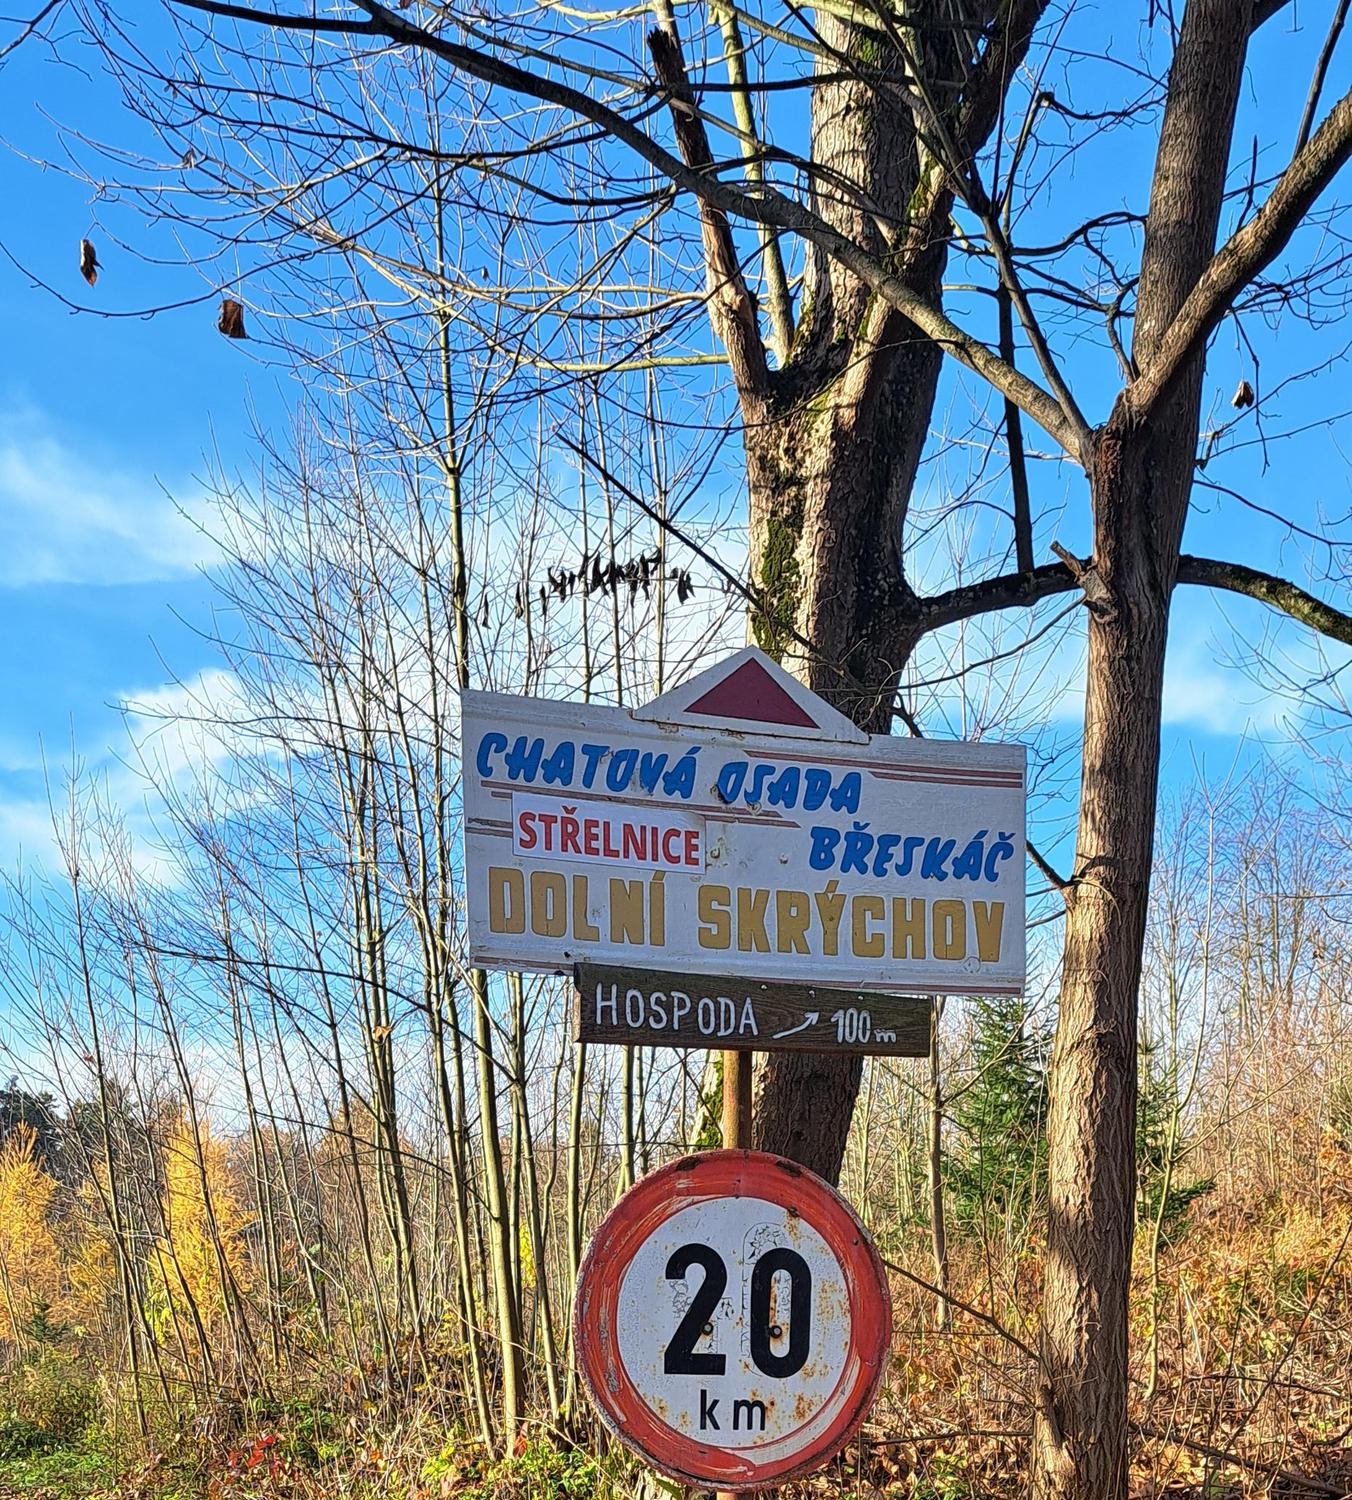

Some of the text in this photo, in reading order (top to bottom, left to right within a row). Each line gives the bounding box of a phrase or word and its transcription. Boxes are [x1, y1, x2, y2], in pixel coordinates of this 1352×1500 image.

[475, 731, 862, 814] CHATOVÁ OSADA
[518, 806, 700, 867] STŘELNICE
[809, 821, 1016, 883] BŘESKÁČ
[487, 866, 1006, 963] DOLNÍ SKRÝCHOV
[595, 982, 760, 1037] HOSPODA
[663, 1242, 812, 1379] 20
[699, 1388, 767, 1432] km
